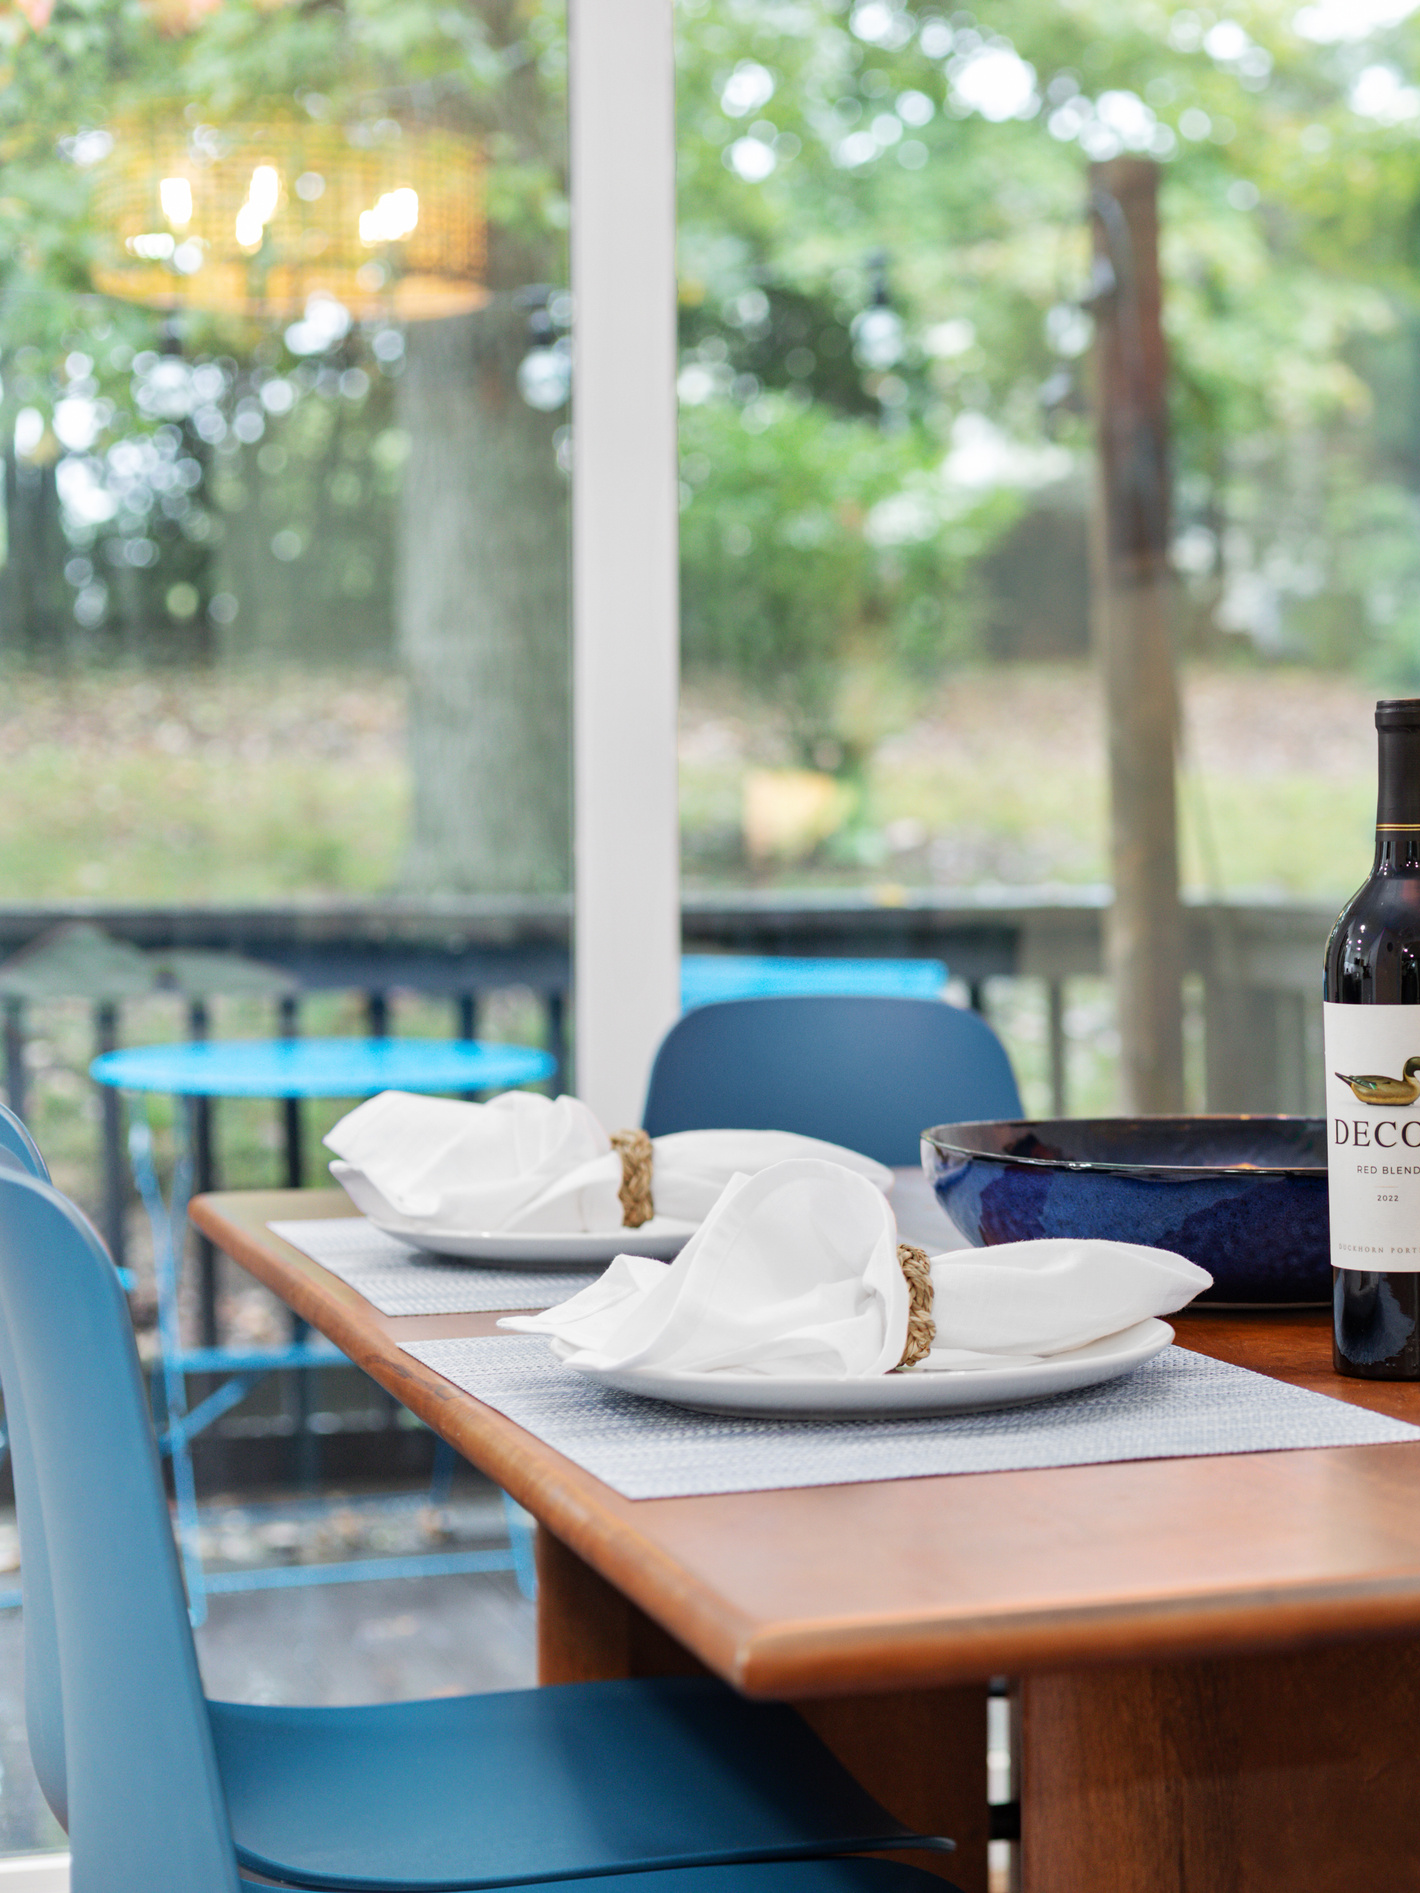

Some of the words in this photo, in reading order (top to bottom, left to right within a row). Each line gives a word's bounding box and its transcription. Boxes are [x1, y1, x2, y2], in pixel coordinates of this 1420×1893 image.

[1356, 1165, 1378, 1174] RED
[1376, 1194, 1399, 1202] 2022
[1338, 1243, 1384, 1253] DUCKHORN
